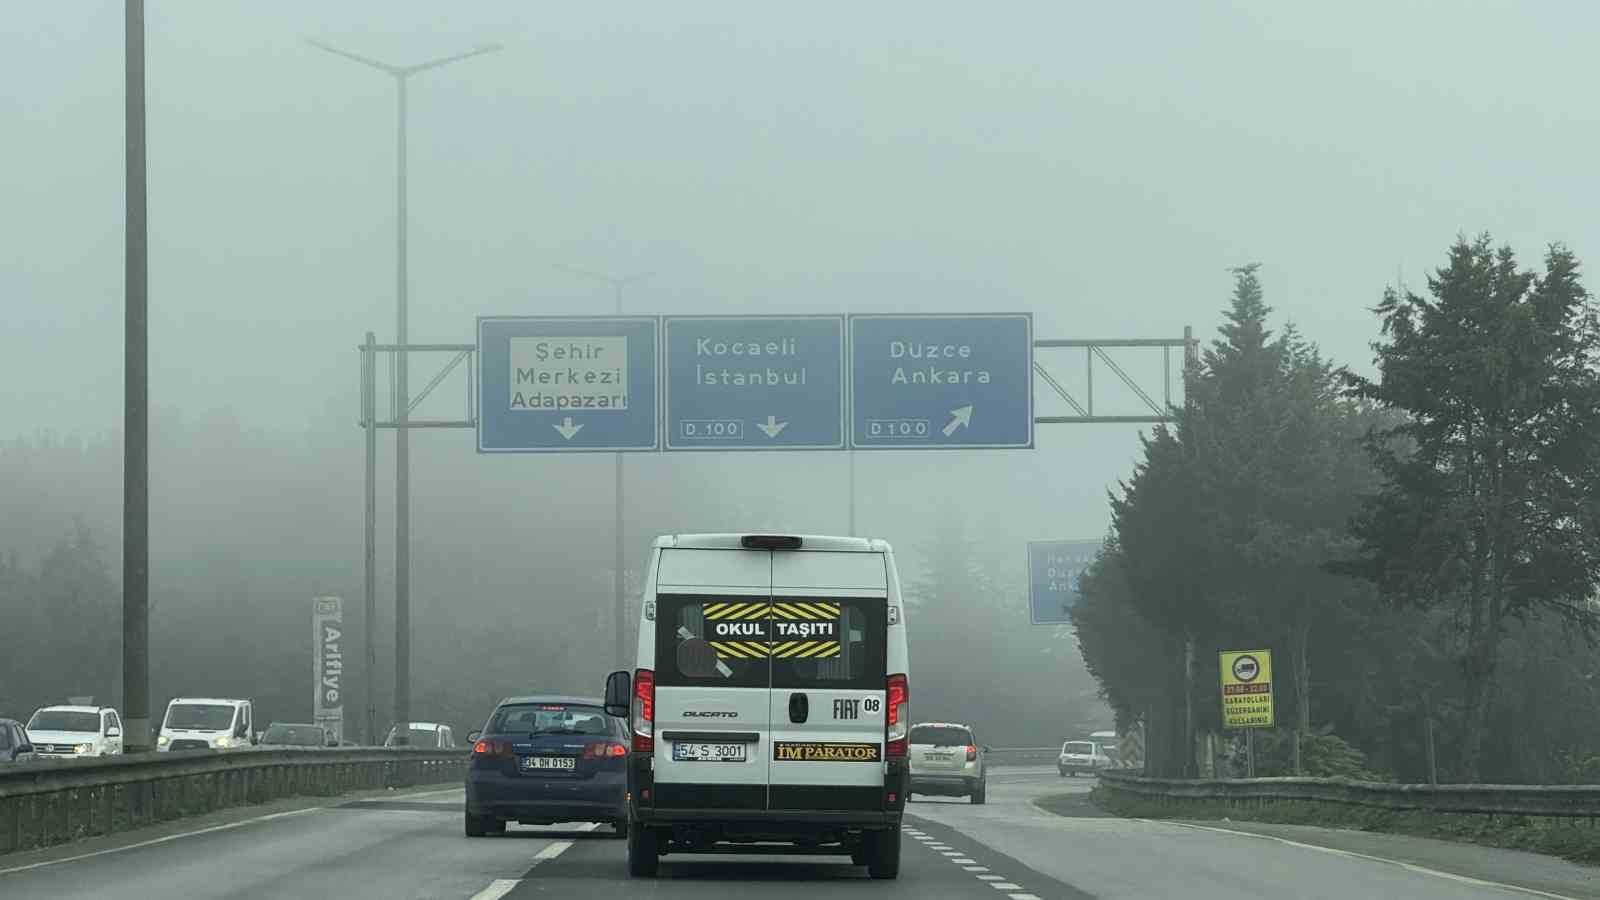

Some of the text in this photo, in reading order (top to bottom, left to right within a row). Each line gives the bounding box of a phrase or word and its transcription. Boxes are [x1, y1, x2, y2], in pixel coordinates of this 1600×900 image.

[535, 342, 605, 360] Şehir
[696, 338, 796, 356] Kocaeli
[516, 368, 621, 384] Merkezi
[696, 365, 806, 386] İstanbul
[891, 367, 991, 384] Ankara
[511, 392, 626, 410] Adapazarı
[686, 422, 738, 435] D 100
[871, 422, 926, 435] D 100
[716, 623, 833, 638] OKUL TAŞITI
[323, 626, 342, 702] Arifiye
[833, 698, 859, 719] FIAT
[864, 699, 880, 712] 08
[682, 711, 738, 719] DUCATO
[680, 745, 741, 756] 54 S 3001
